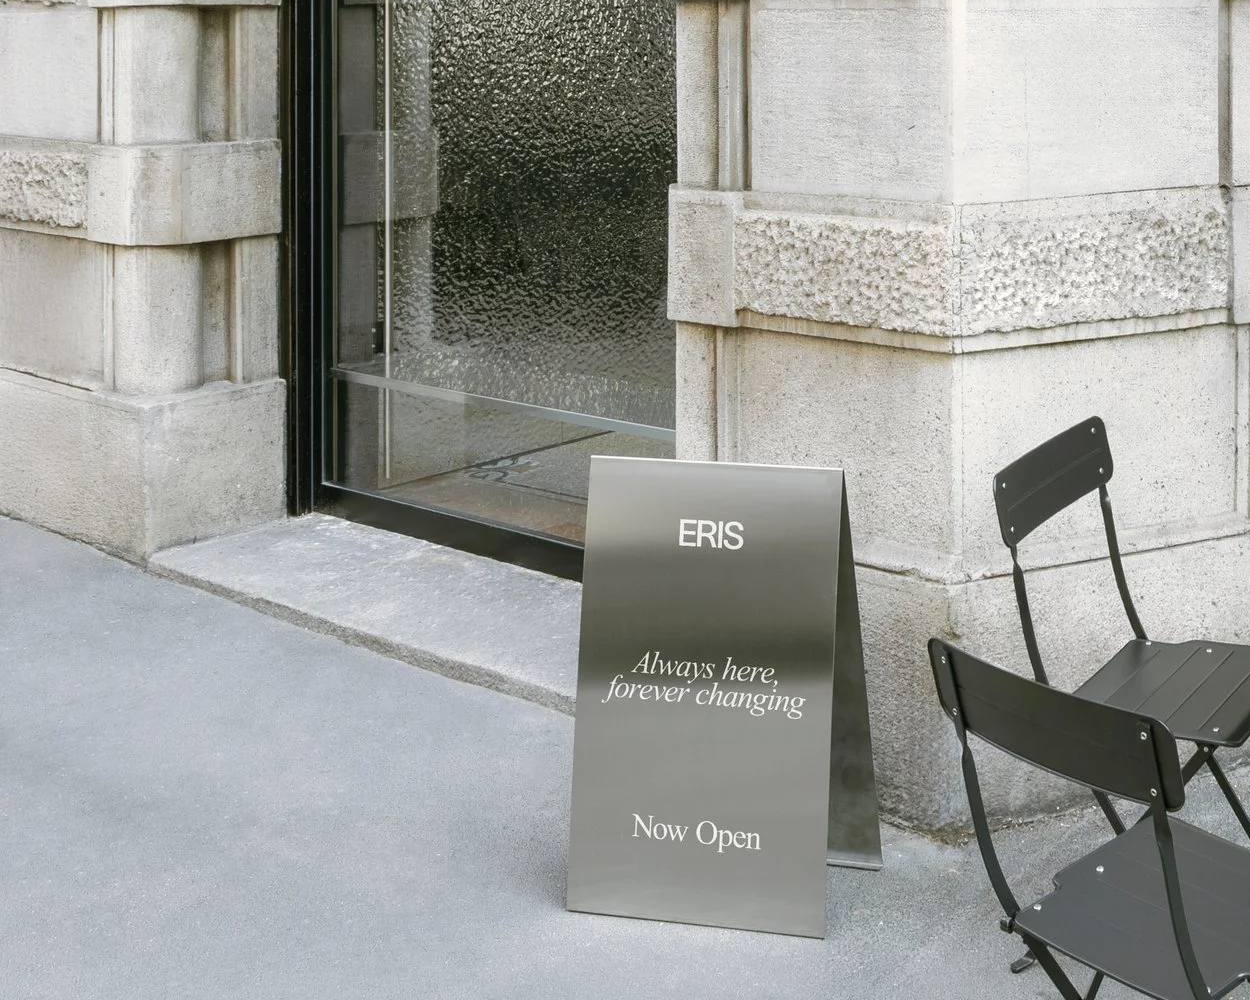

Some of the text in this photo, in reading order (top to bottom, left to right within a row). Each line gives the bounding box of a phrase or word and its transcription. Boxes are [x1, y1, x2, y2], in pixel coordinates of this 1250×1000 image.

[678, 518, 744, 550] ERIS
[630, 650, 778, 687] Always here,
[601, 673, 806, 720] forever changing
[631, 813, 762, 853] Now Open
